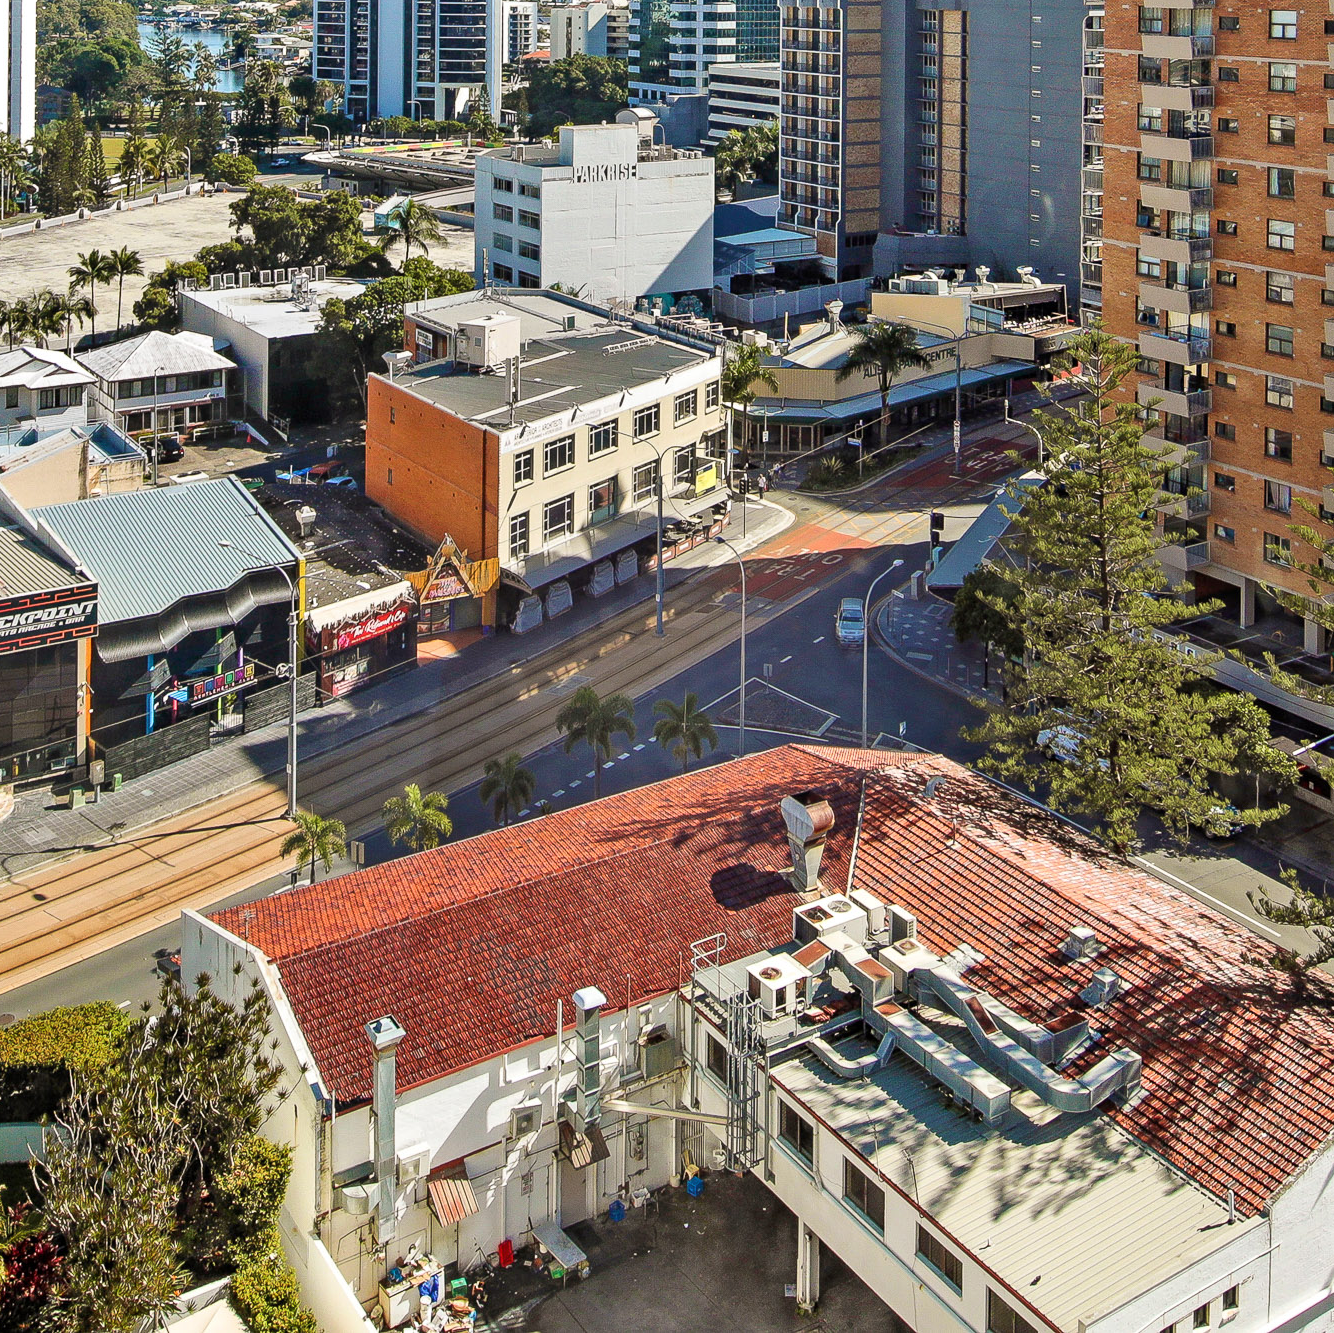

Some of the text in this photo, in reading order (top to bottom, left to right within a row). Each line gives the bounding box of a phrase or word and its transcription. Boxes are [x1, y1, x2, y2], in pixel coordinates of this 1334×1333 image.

[574, 162, 637, 184] PARKRISE
[925, 346, 957, 363] CENTRE
[19, 621, 56, 634] ARCADE
[65, 616, 86, 625] BAR
